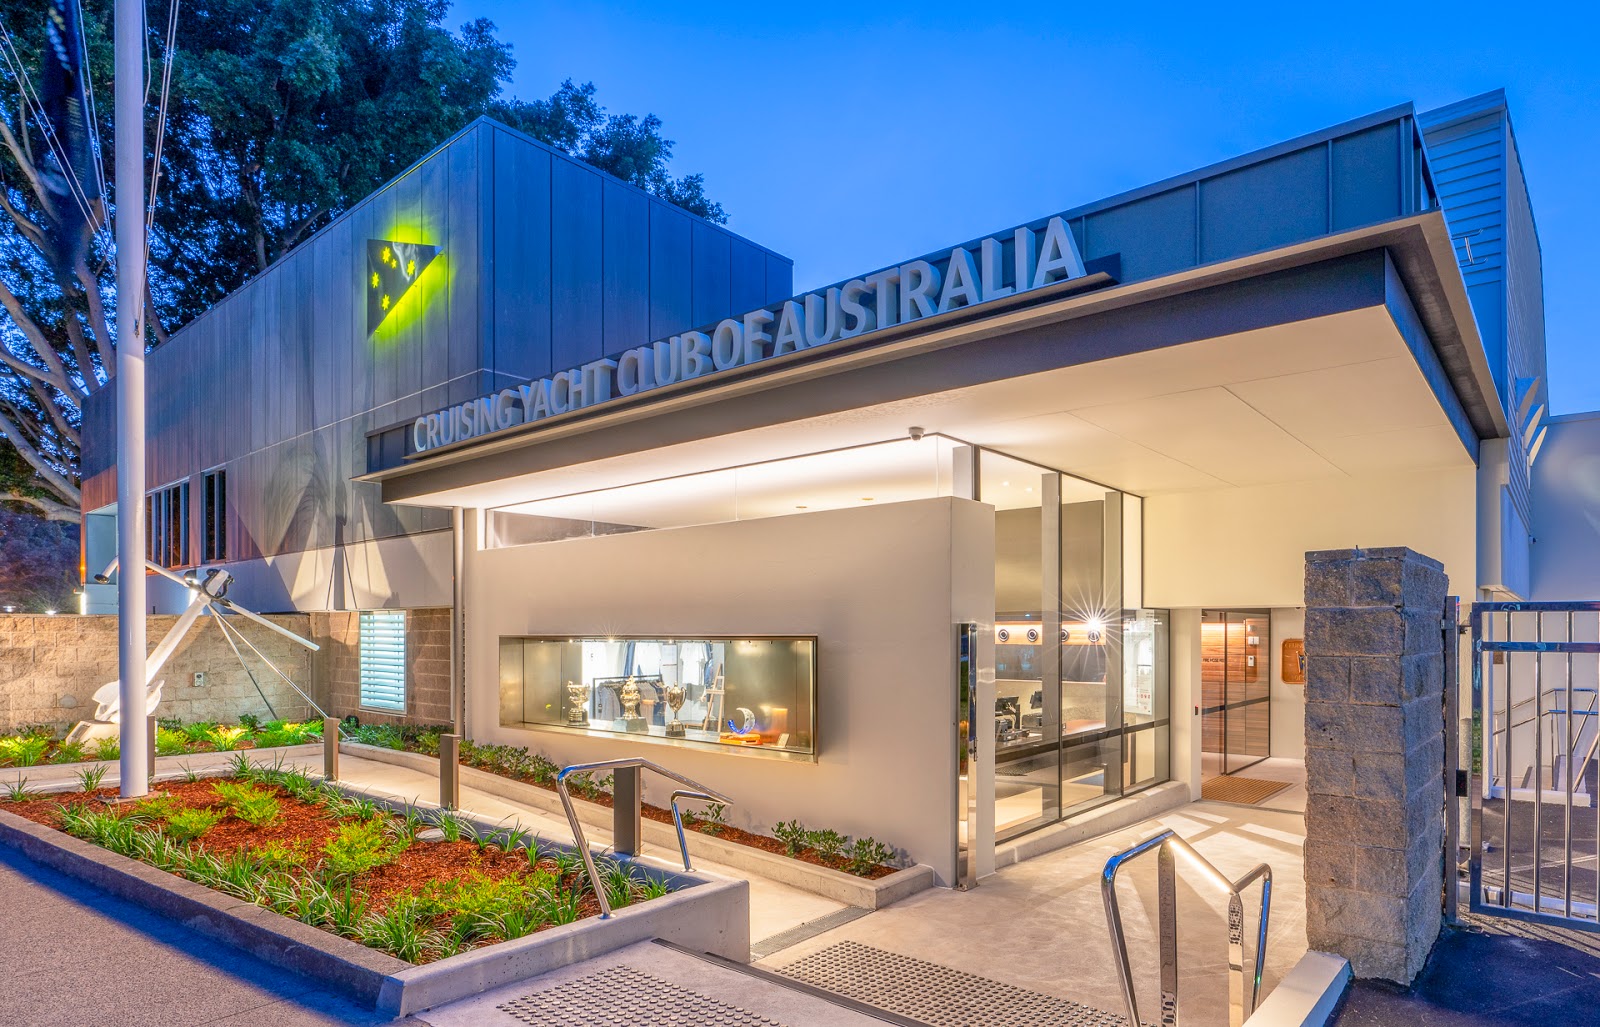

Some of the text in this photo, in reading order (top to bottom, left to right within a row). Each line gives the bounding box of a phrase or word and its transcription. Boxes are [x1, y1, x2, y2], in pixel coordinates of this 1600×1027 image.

[414, 216, 1086, 452] CRUISING YACHT CLUB OF AUSTRALIA
